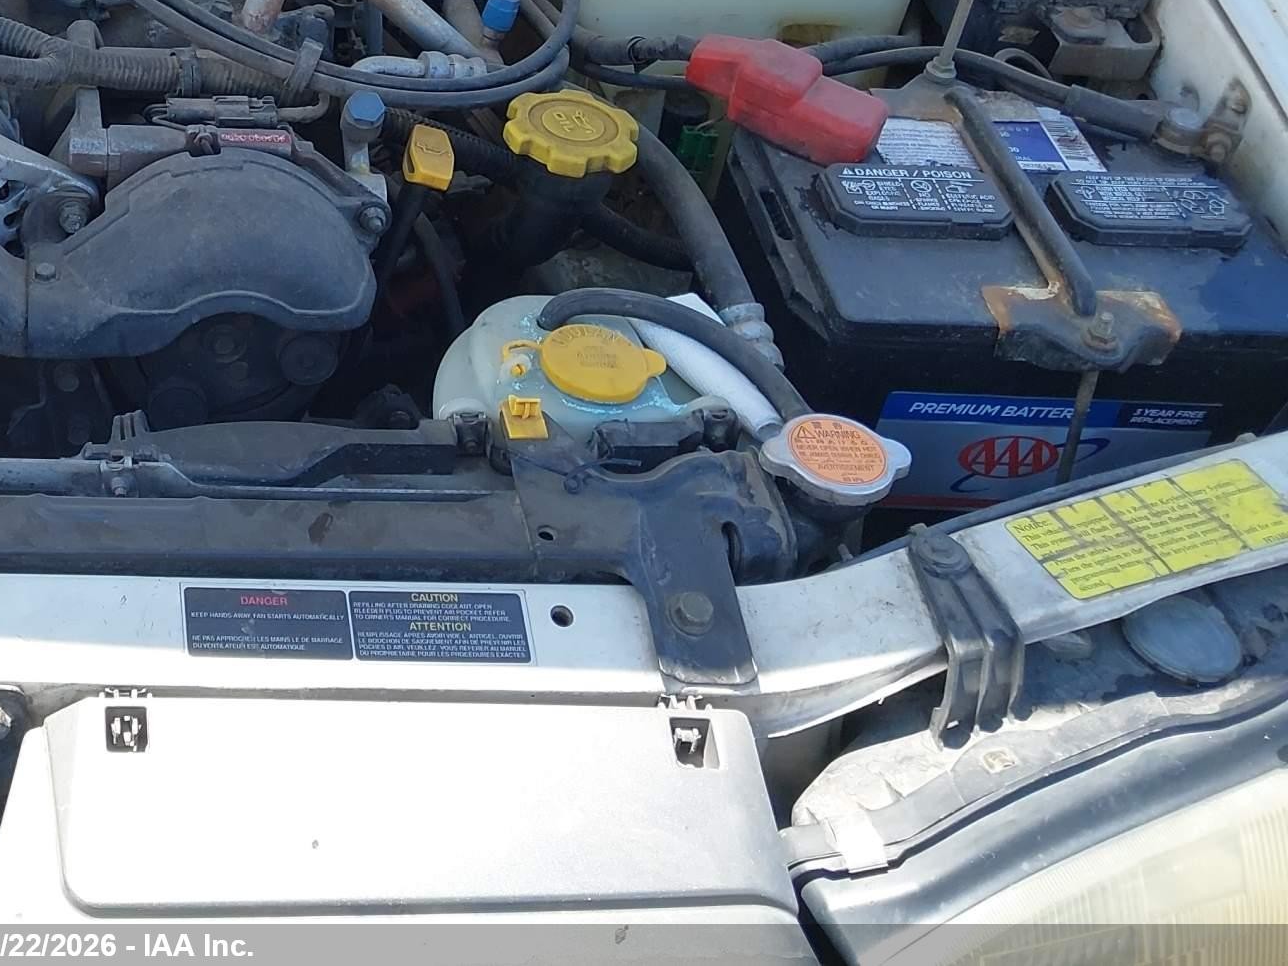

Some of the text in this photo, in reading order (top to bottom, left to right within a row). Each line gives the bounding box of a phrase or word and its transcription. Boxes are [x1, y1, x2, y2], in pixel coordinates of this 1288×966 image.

[551, 112, 574, 133] OIL
[854, 168, 909, 177] DANGER
[922, 170, 972, 179] POISON
[908, 401, 1088, 419] PREMIUM BATTER
[1135, 408, 1208, 419] 3 YEAR FREE
[1129, 416, 1202, 425] REPLACEMENT
[815, 429, 861, 439] WARNING
[968, 436, 1046, 475] AAA
[240, 596, 288, 606] DANGER
[411, 593, 459, 603] CAUTION
[292, 613, 345, 621] AUTOMATICALLY
[409, 622, 472, 632] ATTENTION
[260, 643, 306, 651] AUTOMATIQUE
